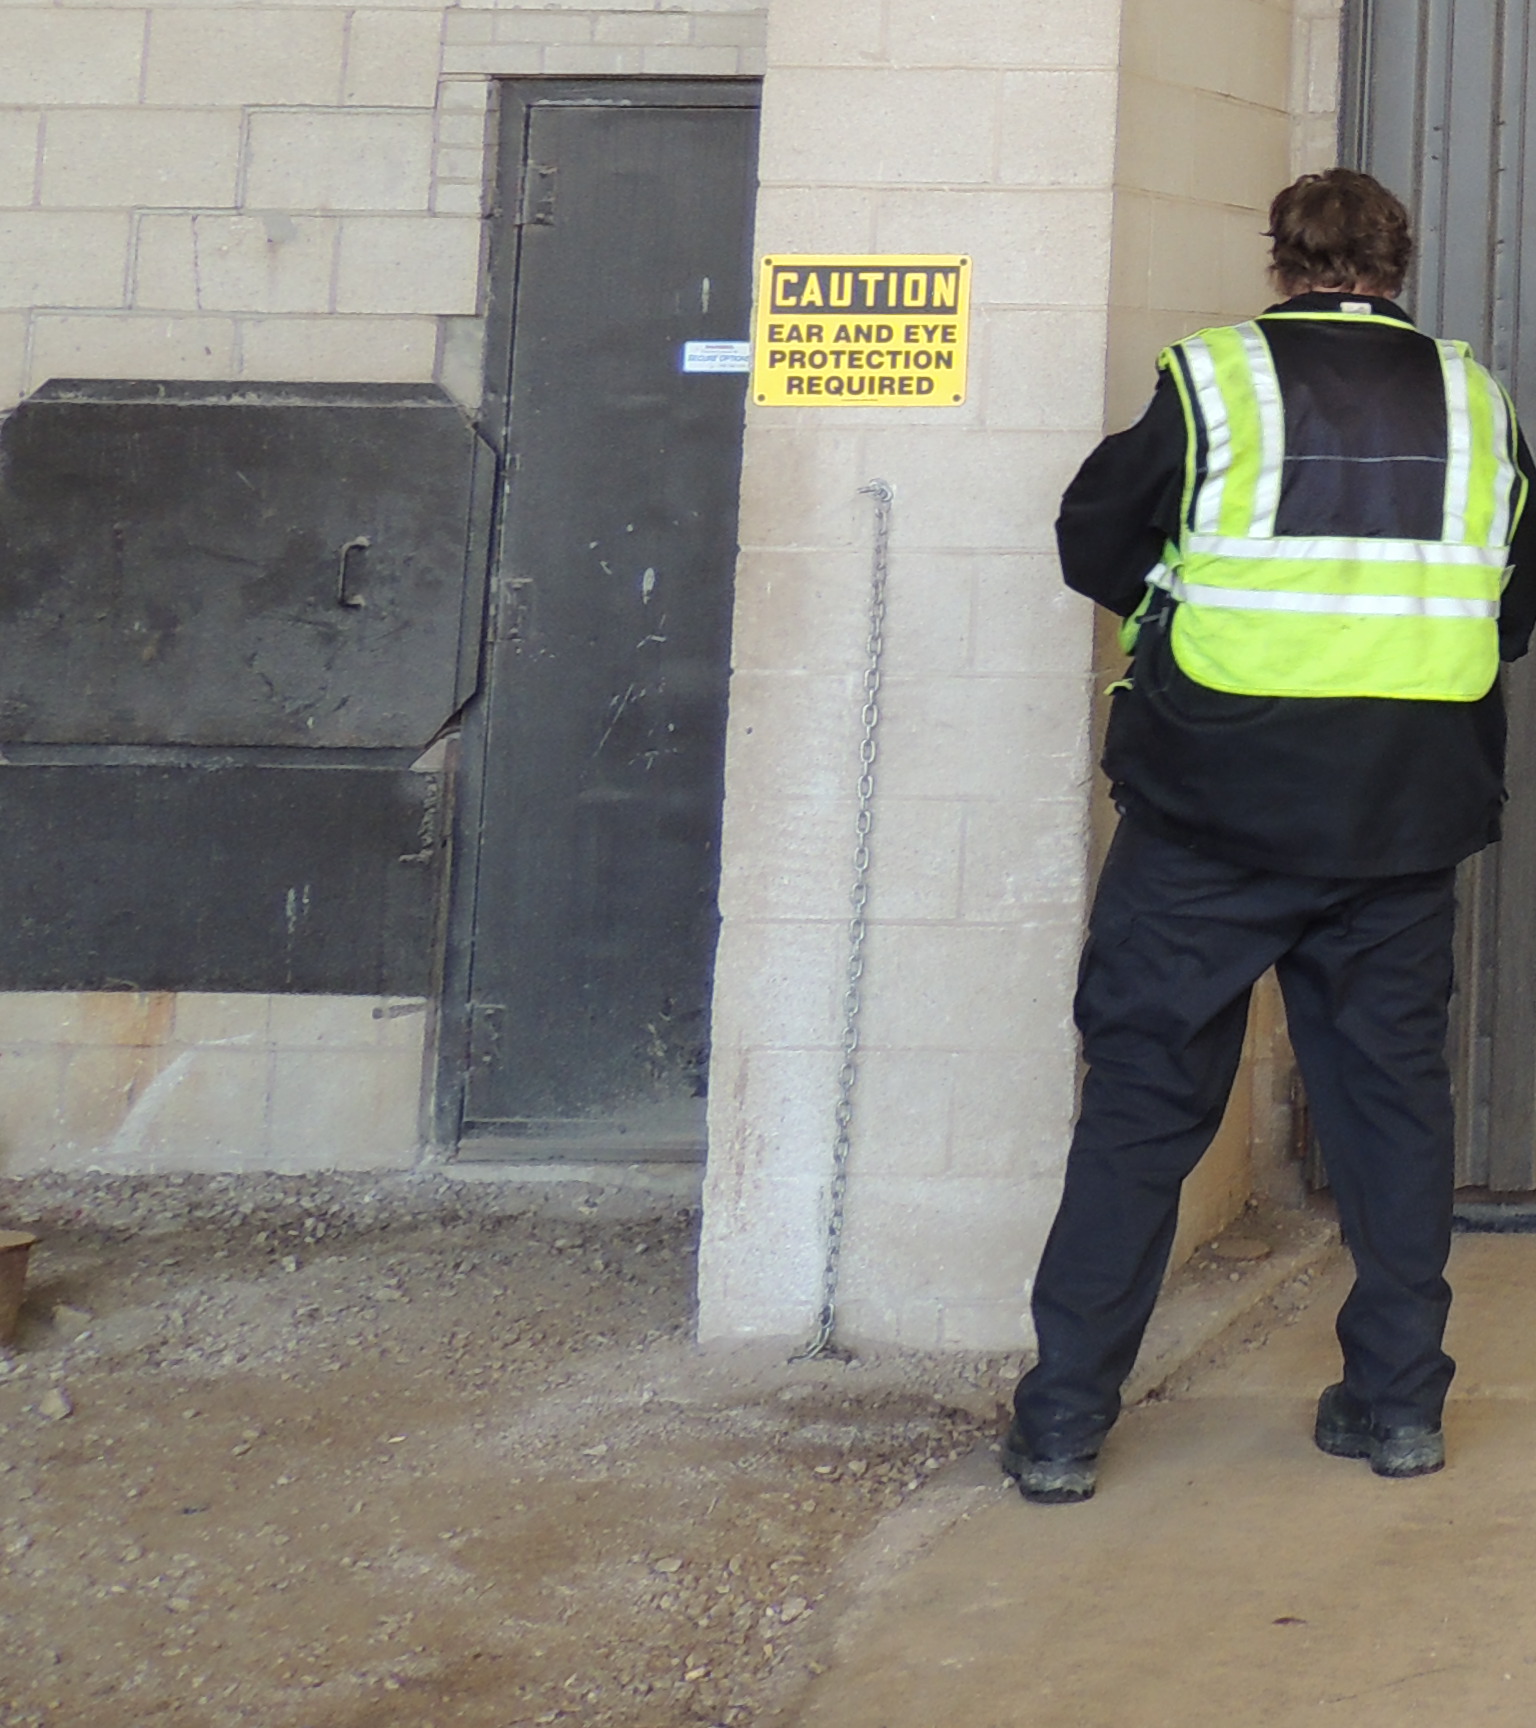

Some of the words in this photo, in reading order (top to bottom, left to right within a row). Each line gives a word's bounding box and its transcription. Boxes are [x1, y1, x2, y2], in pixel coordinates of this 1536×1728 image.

[775, 271, 956, 308] CAUTION
[768, 324, 823, 344] EAR
[833, 325, 893, 344] AND
[904, 324, 957, 344] EYE
[768, 350, 954, 370] PROTECTION
[786, 376, 934, 397] REQUIRED
